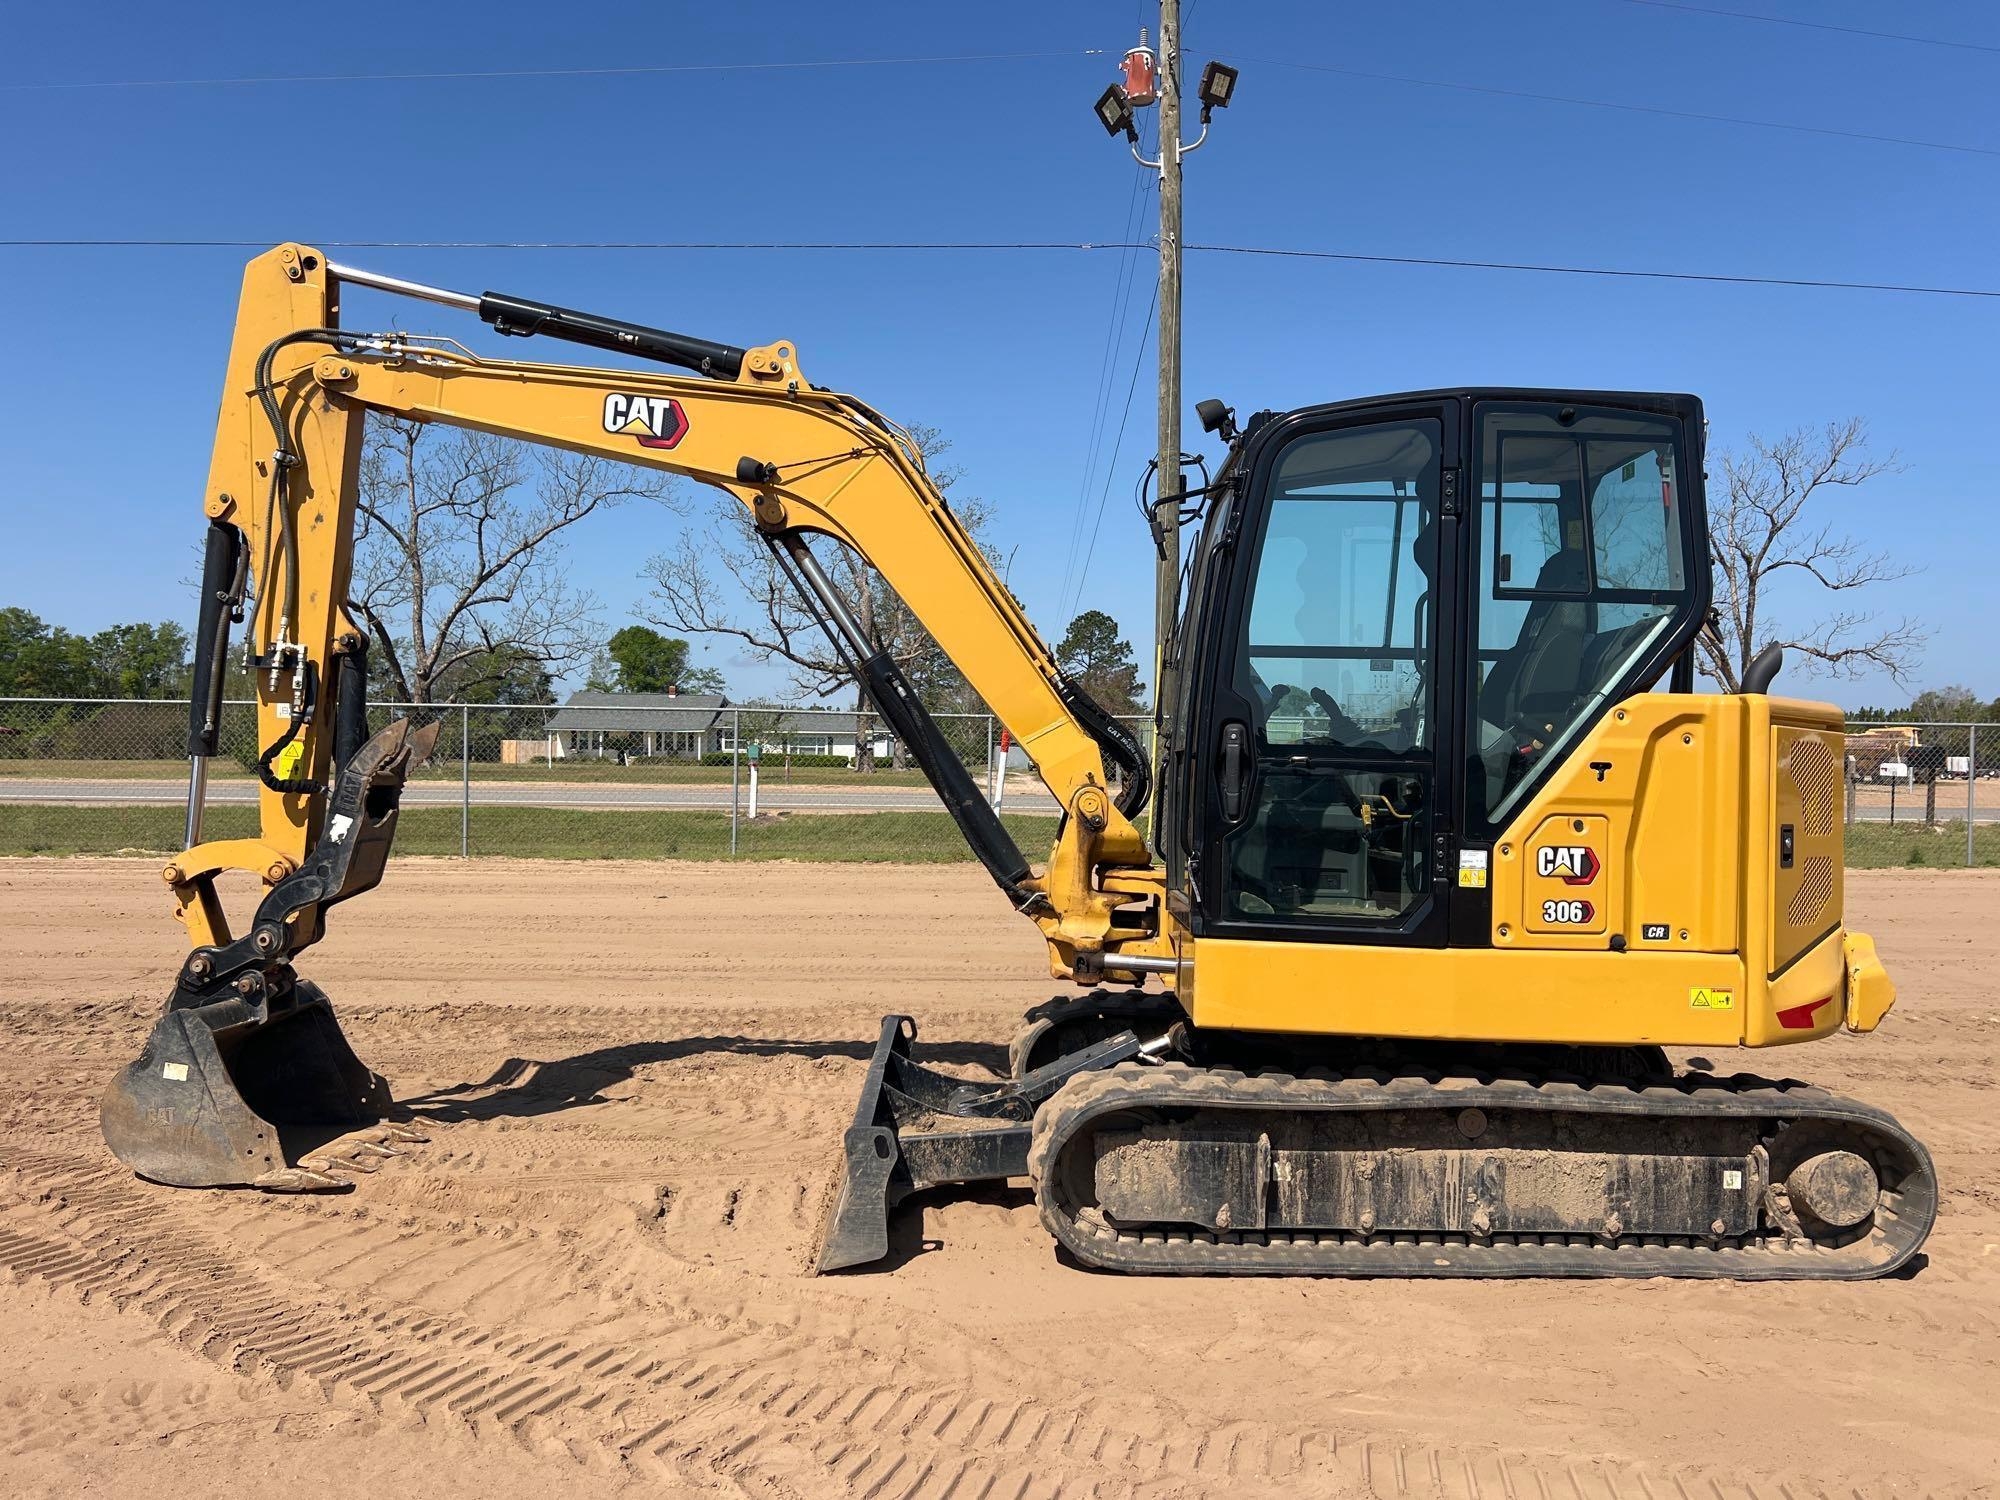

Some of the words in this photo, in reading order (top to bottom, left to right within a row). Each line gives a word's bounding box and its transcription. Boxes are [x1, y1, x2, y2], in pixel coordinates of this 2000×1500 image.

[604, 394, 670, 437] CAT
[1107, 726, 1121, 738] CAT
[1538, 847, 1585, 877] CAT
[1543, 901, 1583, 923] 306
[1648, 927, 1665, 938] CR
